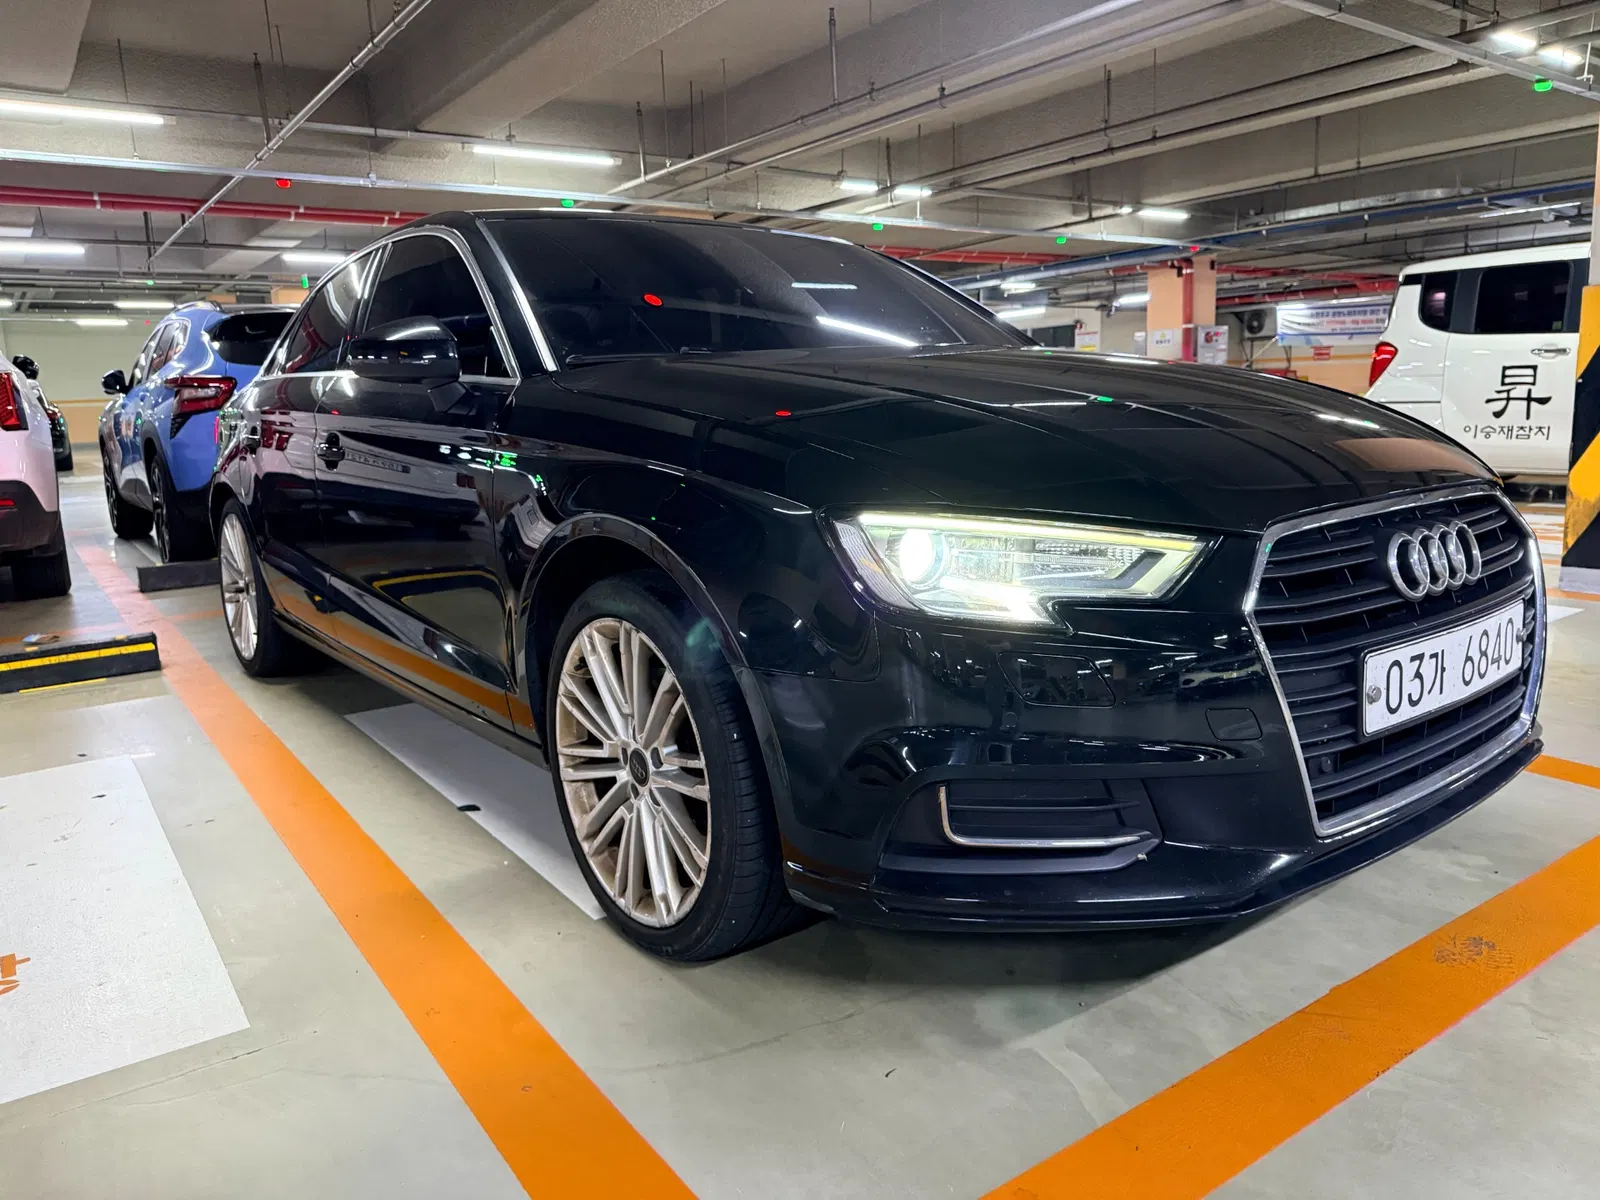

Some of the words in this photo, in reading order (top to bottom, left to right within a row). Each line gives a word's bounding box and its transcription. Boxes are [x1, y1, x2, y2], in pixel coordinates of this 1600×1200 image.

[1485, 364, 1552, 420] 昇
[1385, 649, 1446, 715] 03가
[1462, 617, 1514, 686] 6840
